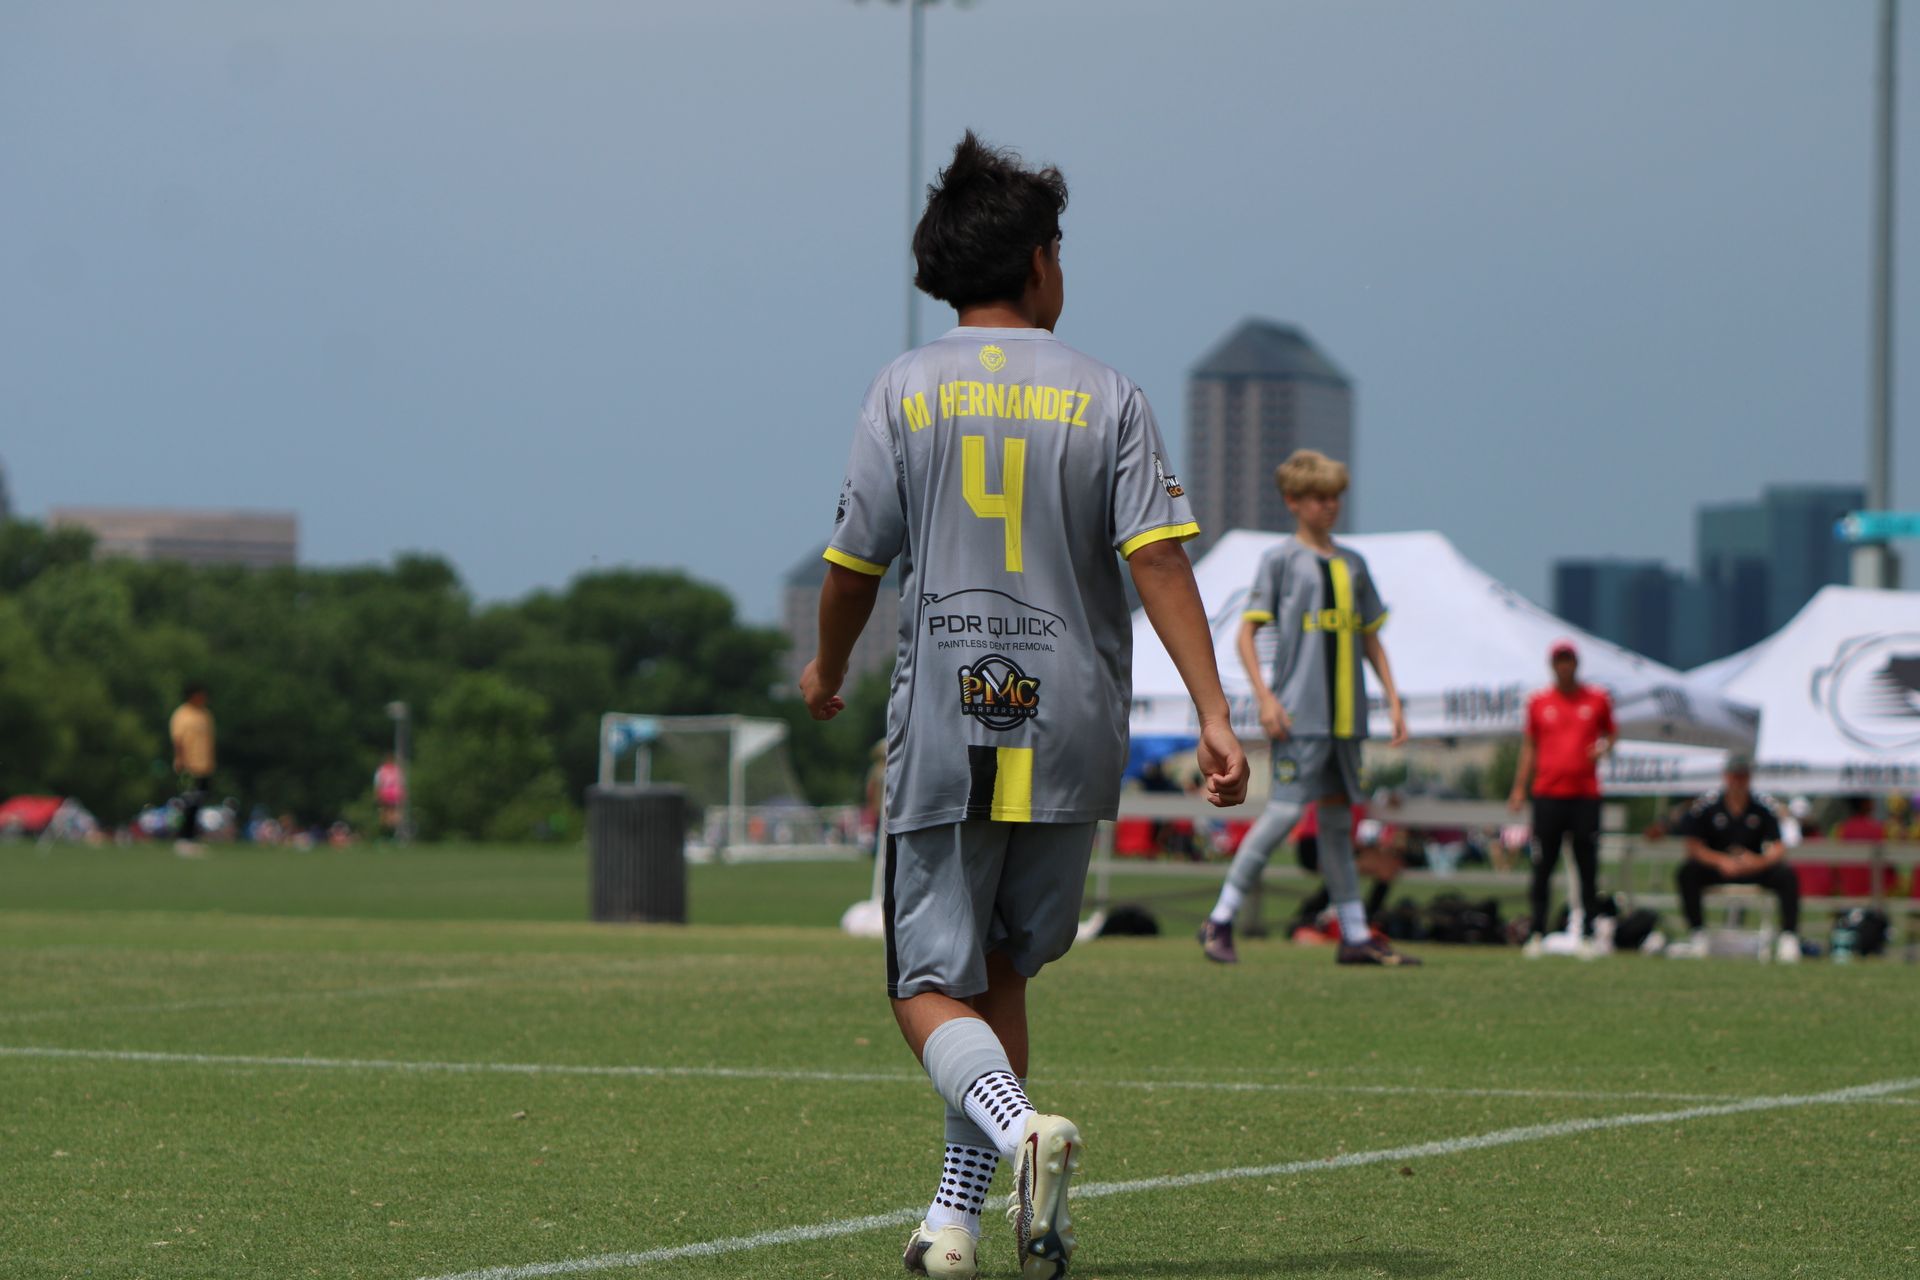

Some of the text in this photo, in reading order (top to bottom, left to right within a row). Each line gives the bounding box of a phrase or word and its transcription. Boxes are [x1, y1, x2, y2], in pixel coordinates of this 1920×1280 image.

[902, 380, 1092, 433] M HERNANDEZ
[961, 435, 1026, 573] 4
[929, 615, 1058, 638] PDR QUICK
[938, 640, 1055, 652] PAINTLESS DENT REMOVAL
